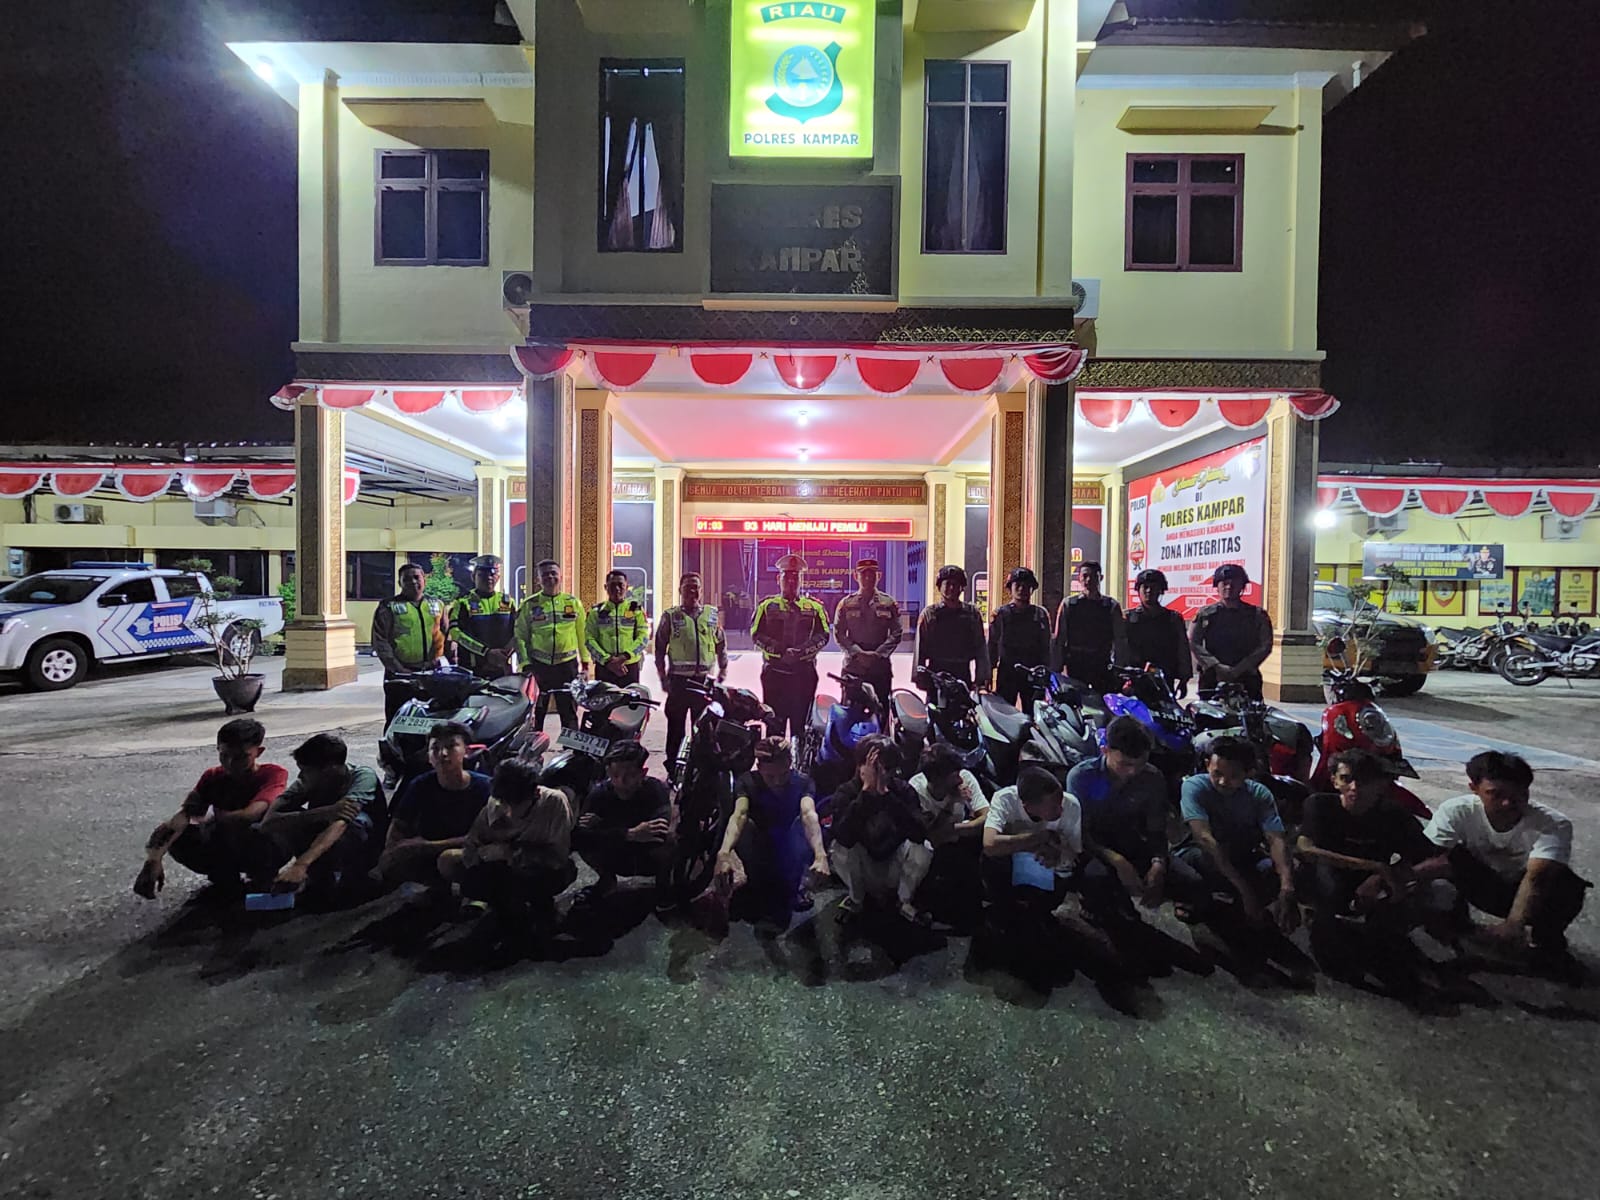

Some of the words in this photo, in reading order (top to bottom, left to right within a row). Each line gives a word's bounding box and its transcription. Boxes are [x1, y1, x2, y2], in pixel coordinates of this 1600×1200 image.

[768, 5, 837, 19] RIAU
[744, 133, 796, 145] POLRES
[803, 133, 859, 146] KAMPAR
[688, 485, 717, 496] SEMUA
[722, 486, 751, 496] POLISI
[877, 487, 902, 497] PINTU
[909, 487, 921, 497] INI
[1130, 498, 1147, 512] POLISI
[1160, 508, 1194, 529] POLRES
[1197, 497, 1245, 521] KAMPAR
[762, 521, 787, 531] HARI
[1161, 544, 1182, 560] ZONA
[1184, 536, 1241, 558] INTEGRITAS
[153, 614, 183, 628] POLISI
